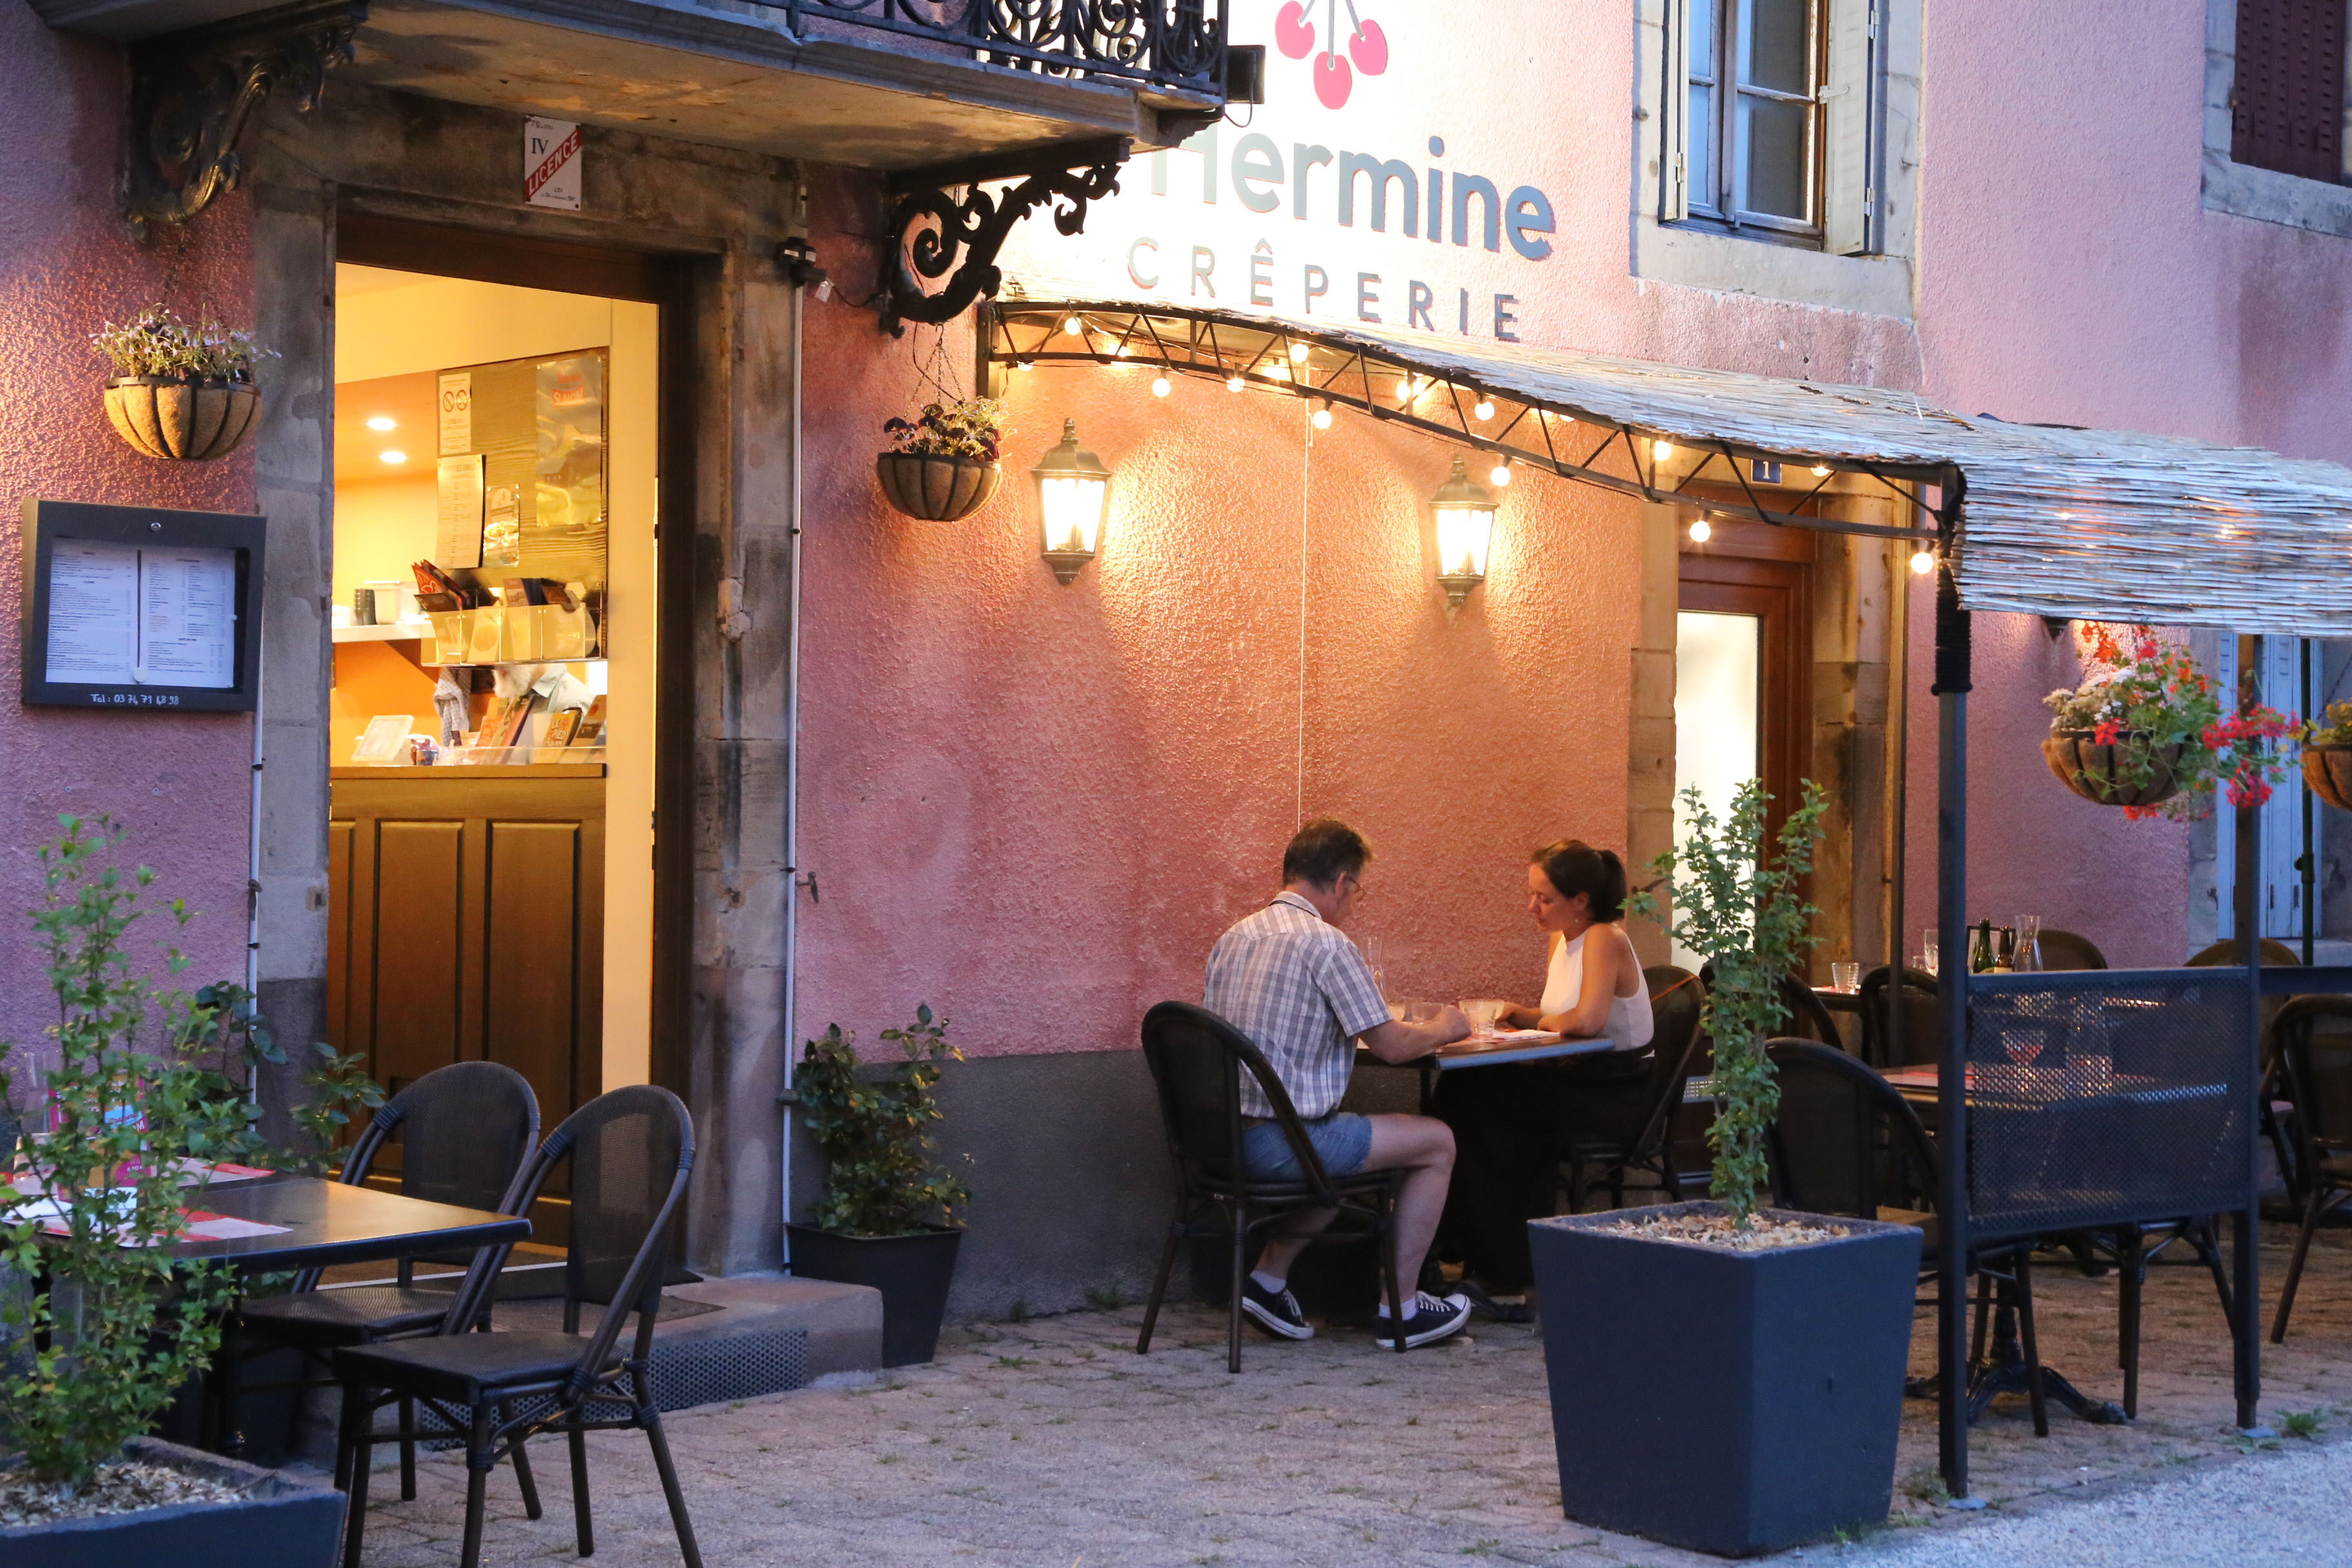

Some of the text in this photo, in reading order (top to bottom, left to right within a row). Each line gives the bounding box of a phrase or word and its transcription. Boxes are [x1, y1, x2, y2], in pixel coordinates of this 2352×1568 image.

[531, 137, 549, 155] IV
[528, 131, 578, 196] LICENCE
[1127, 237, 1520, 342] CRÊPERIE
[1763, 460, 1770, 479] 1
[90, 694, 106, 703] Tel
[113, 694, 125, 703] 03
[141, 694, 152, 704] 71
